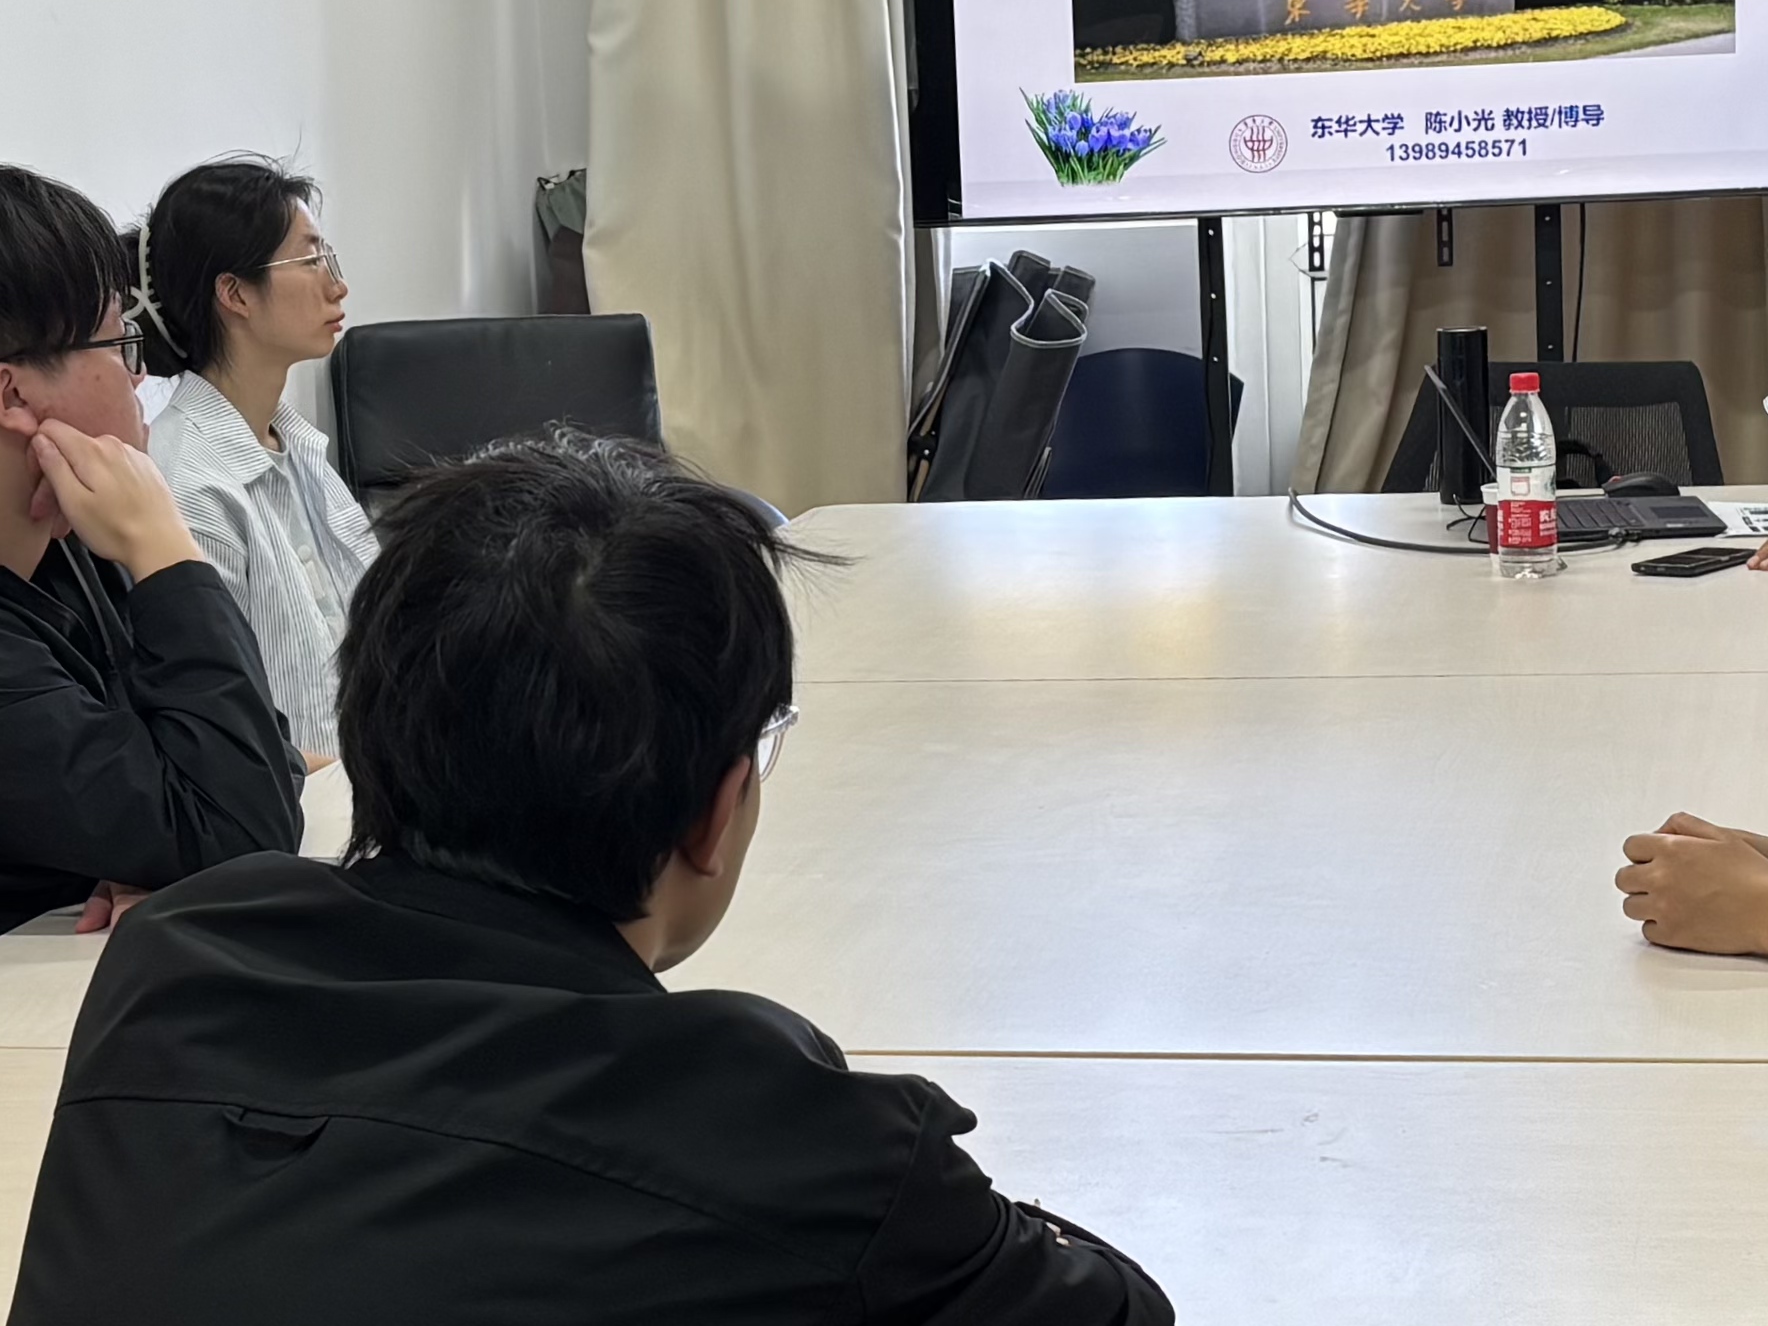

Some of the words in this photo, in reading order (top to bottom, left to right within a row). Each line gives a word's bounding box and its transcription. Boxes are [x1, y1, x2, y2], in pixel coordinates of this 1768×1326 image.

[1310, 112, 1405, 139] 东华大学
[1424, 108, 1495, 135] 陈小光
[1502, 104, 1605, 130] 教授/博导
[1385, 138, 1528, 162] 13989458571
